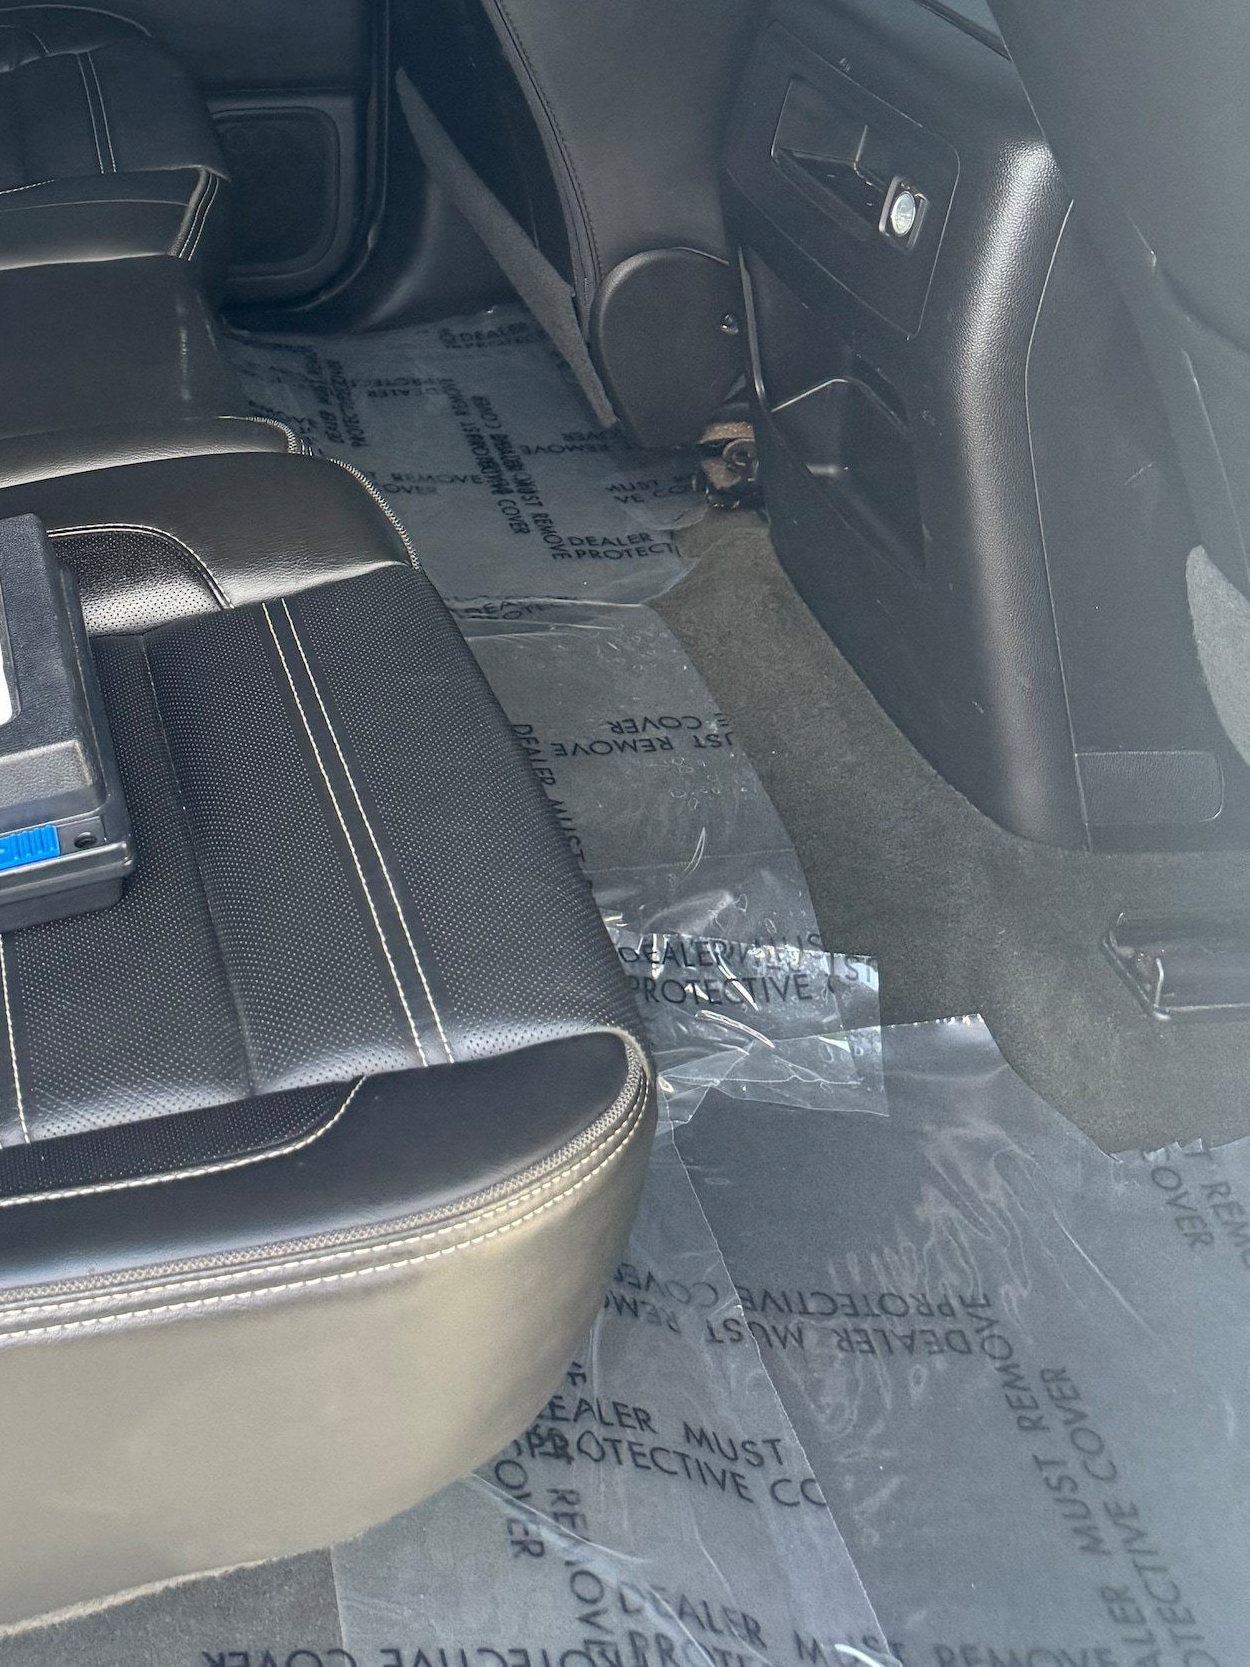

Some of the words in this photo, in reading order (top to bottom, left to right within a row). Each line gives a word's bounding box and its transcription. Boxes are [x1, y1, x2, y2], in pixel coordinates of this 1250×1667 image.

[497, 499, 531, 534] COVER
[568, 532, 654, 547] DEALER
[607, 716, 702, 734] COVER
[551, 736, 674, 757] REMOVE
[625, 974, 812, 1005] PROTECTIVE
[705, 1318, 806, 1350] MUST
[831, 1328, 972, 1355] DEALER
[959, 1292, 1050, 1431] REMOVE
[538, 1394, 658, 1434] EALER
[682, 1420, 784, 1468] MUST
[1040, 1366, 1118, 1483] COVER
[1033, 1454, 1112, 1556] MUST
